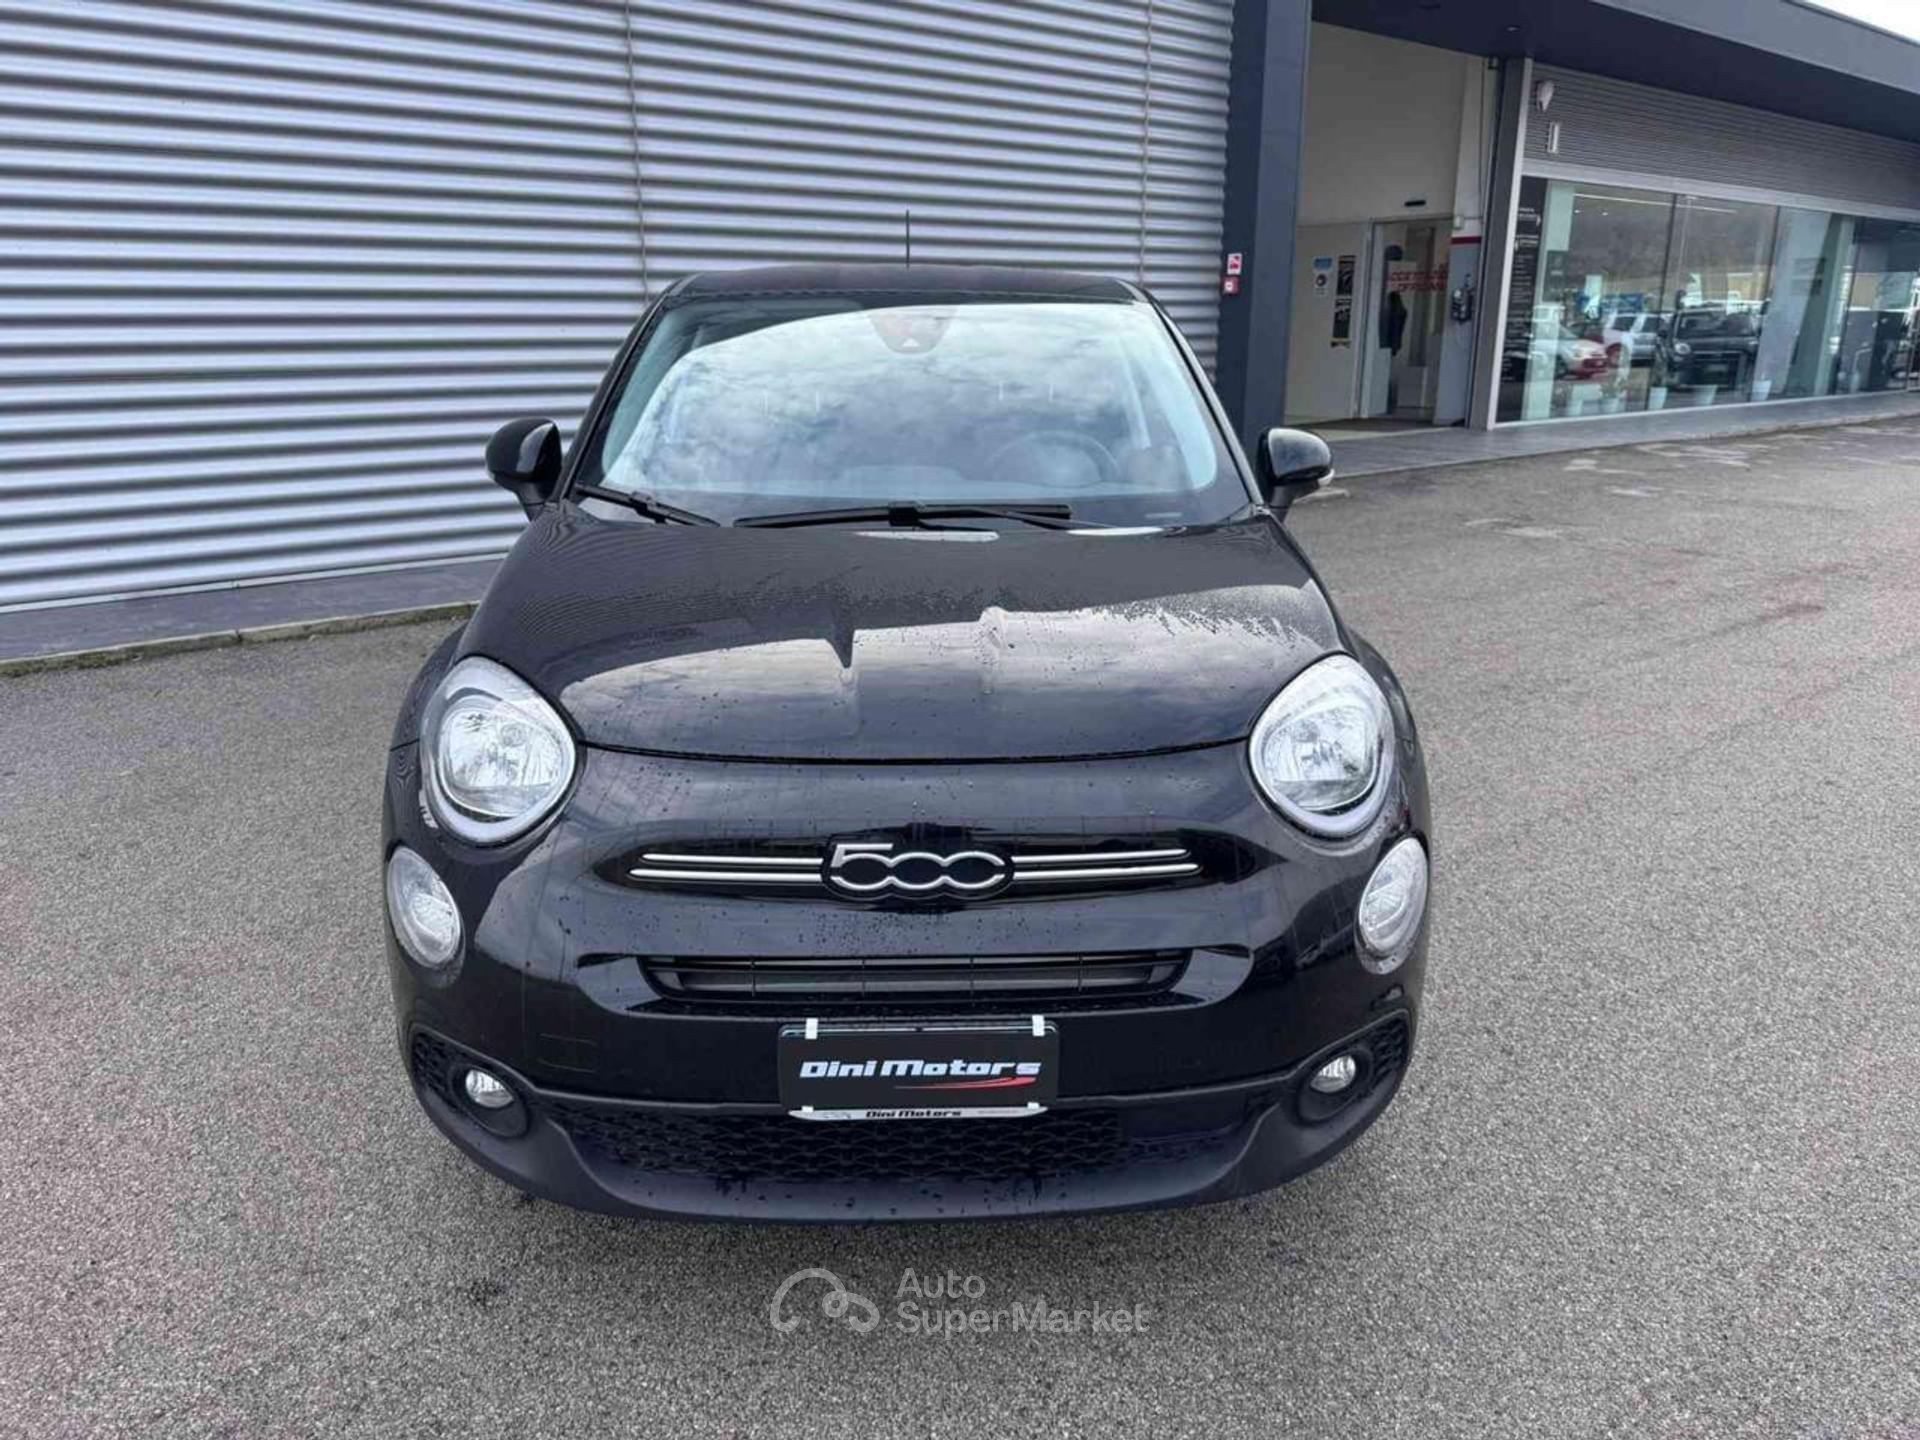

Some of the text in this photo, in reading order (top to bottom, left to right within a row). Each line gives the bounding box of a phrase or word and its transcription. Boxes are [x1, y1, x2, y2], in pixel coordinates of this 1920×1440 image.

[830, 843, 1005, 890] 500
[800, 1059, 1042, 1078] Dini Motors
[865, 1110, 962, 1118] Dini Motors
